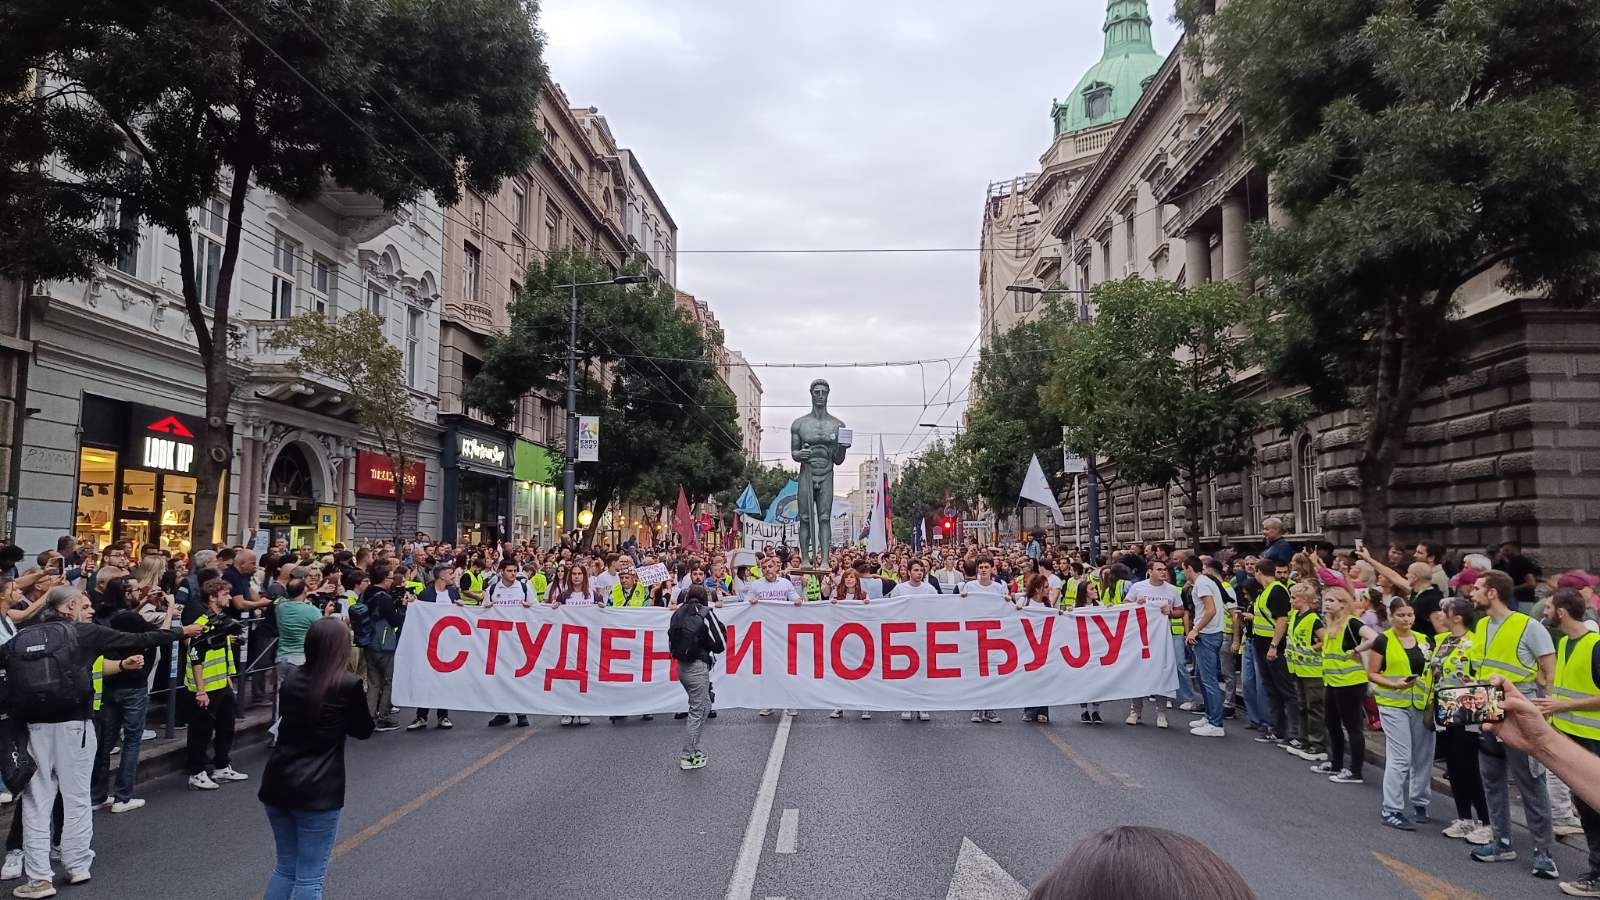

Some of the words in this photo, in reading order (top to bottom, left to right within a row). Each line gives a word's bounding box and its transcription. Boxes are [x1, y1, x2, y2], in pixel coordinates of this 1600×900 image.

[143, 436, 175, 471] LOOK
[176, 442, 194, 473] UP
[426, 615, 762, 693] СТУДЕНИ
[786, 606, 1150, 681] ПОБЕЂУЈУ!
